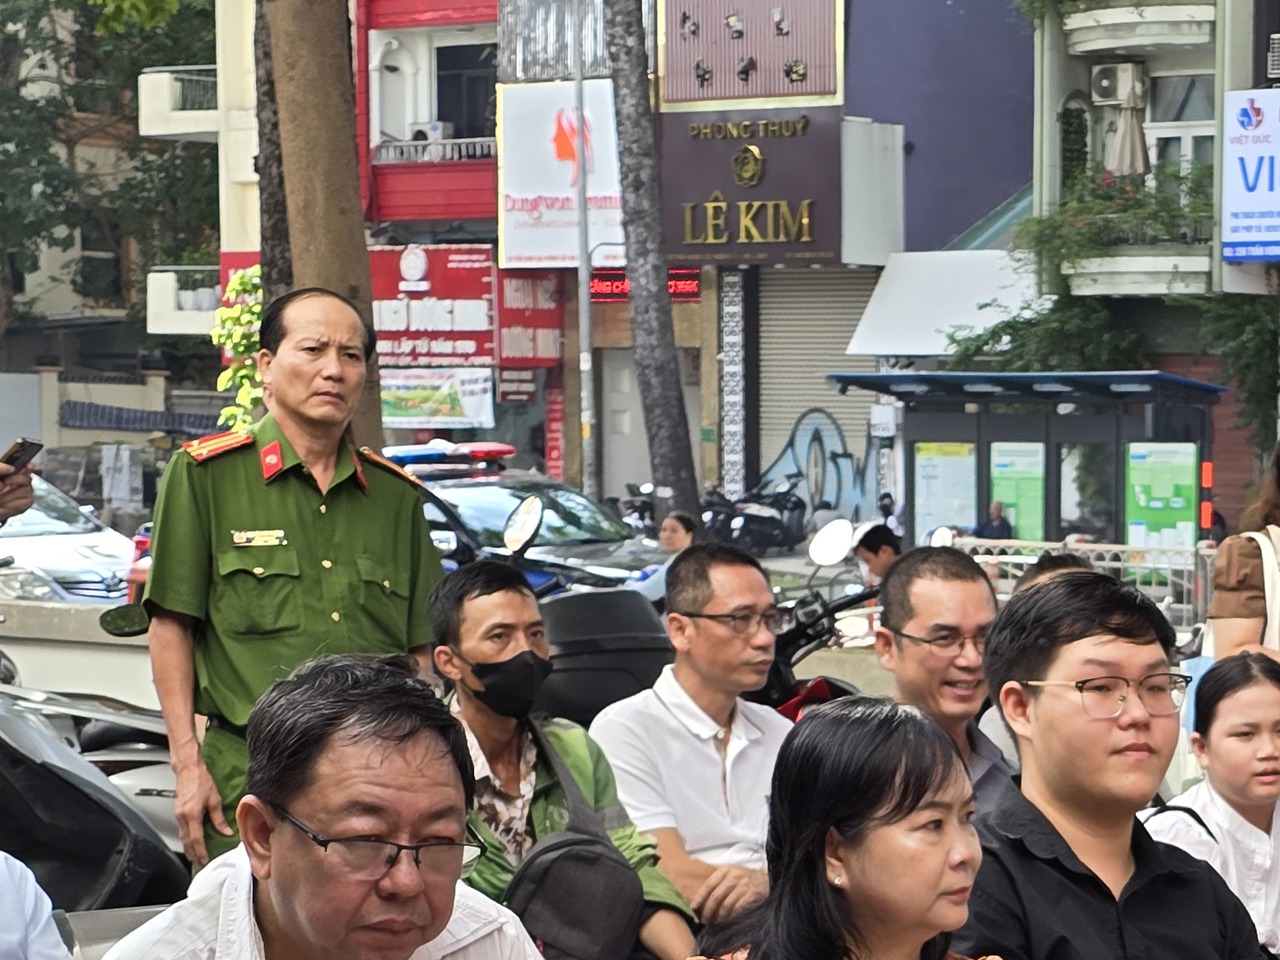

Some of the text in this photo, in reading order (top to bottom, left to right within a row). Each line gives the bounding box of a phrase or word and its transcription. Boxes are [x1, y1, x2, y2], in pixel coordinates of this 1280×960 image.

[689, 120, 751, 139] PHONG
[682, 189, 815, 245] LÊ KIM
